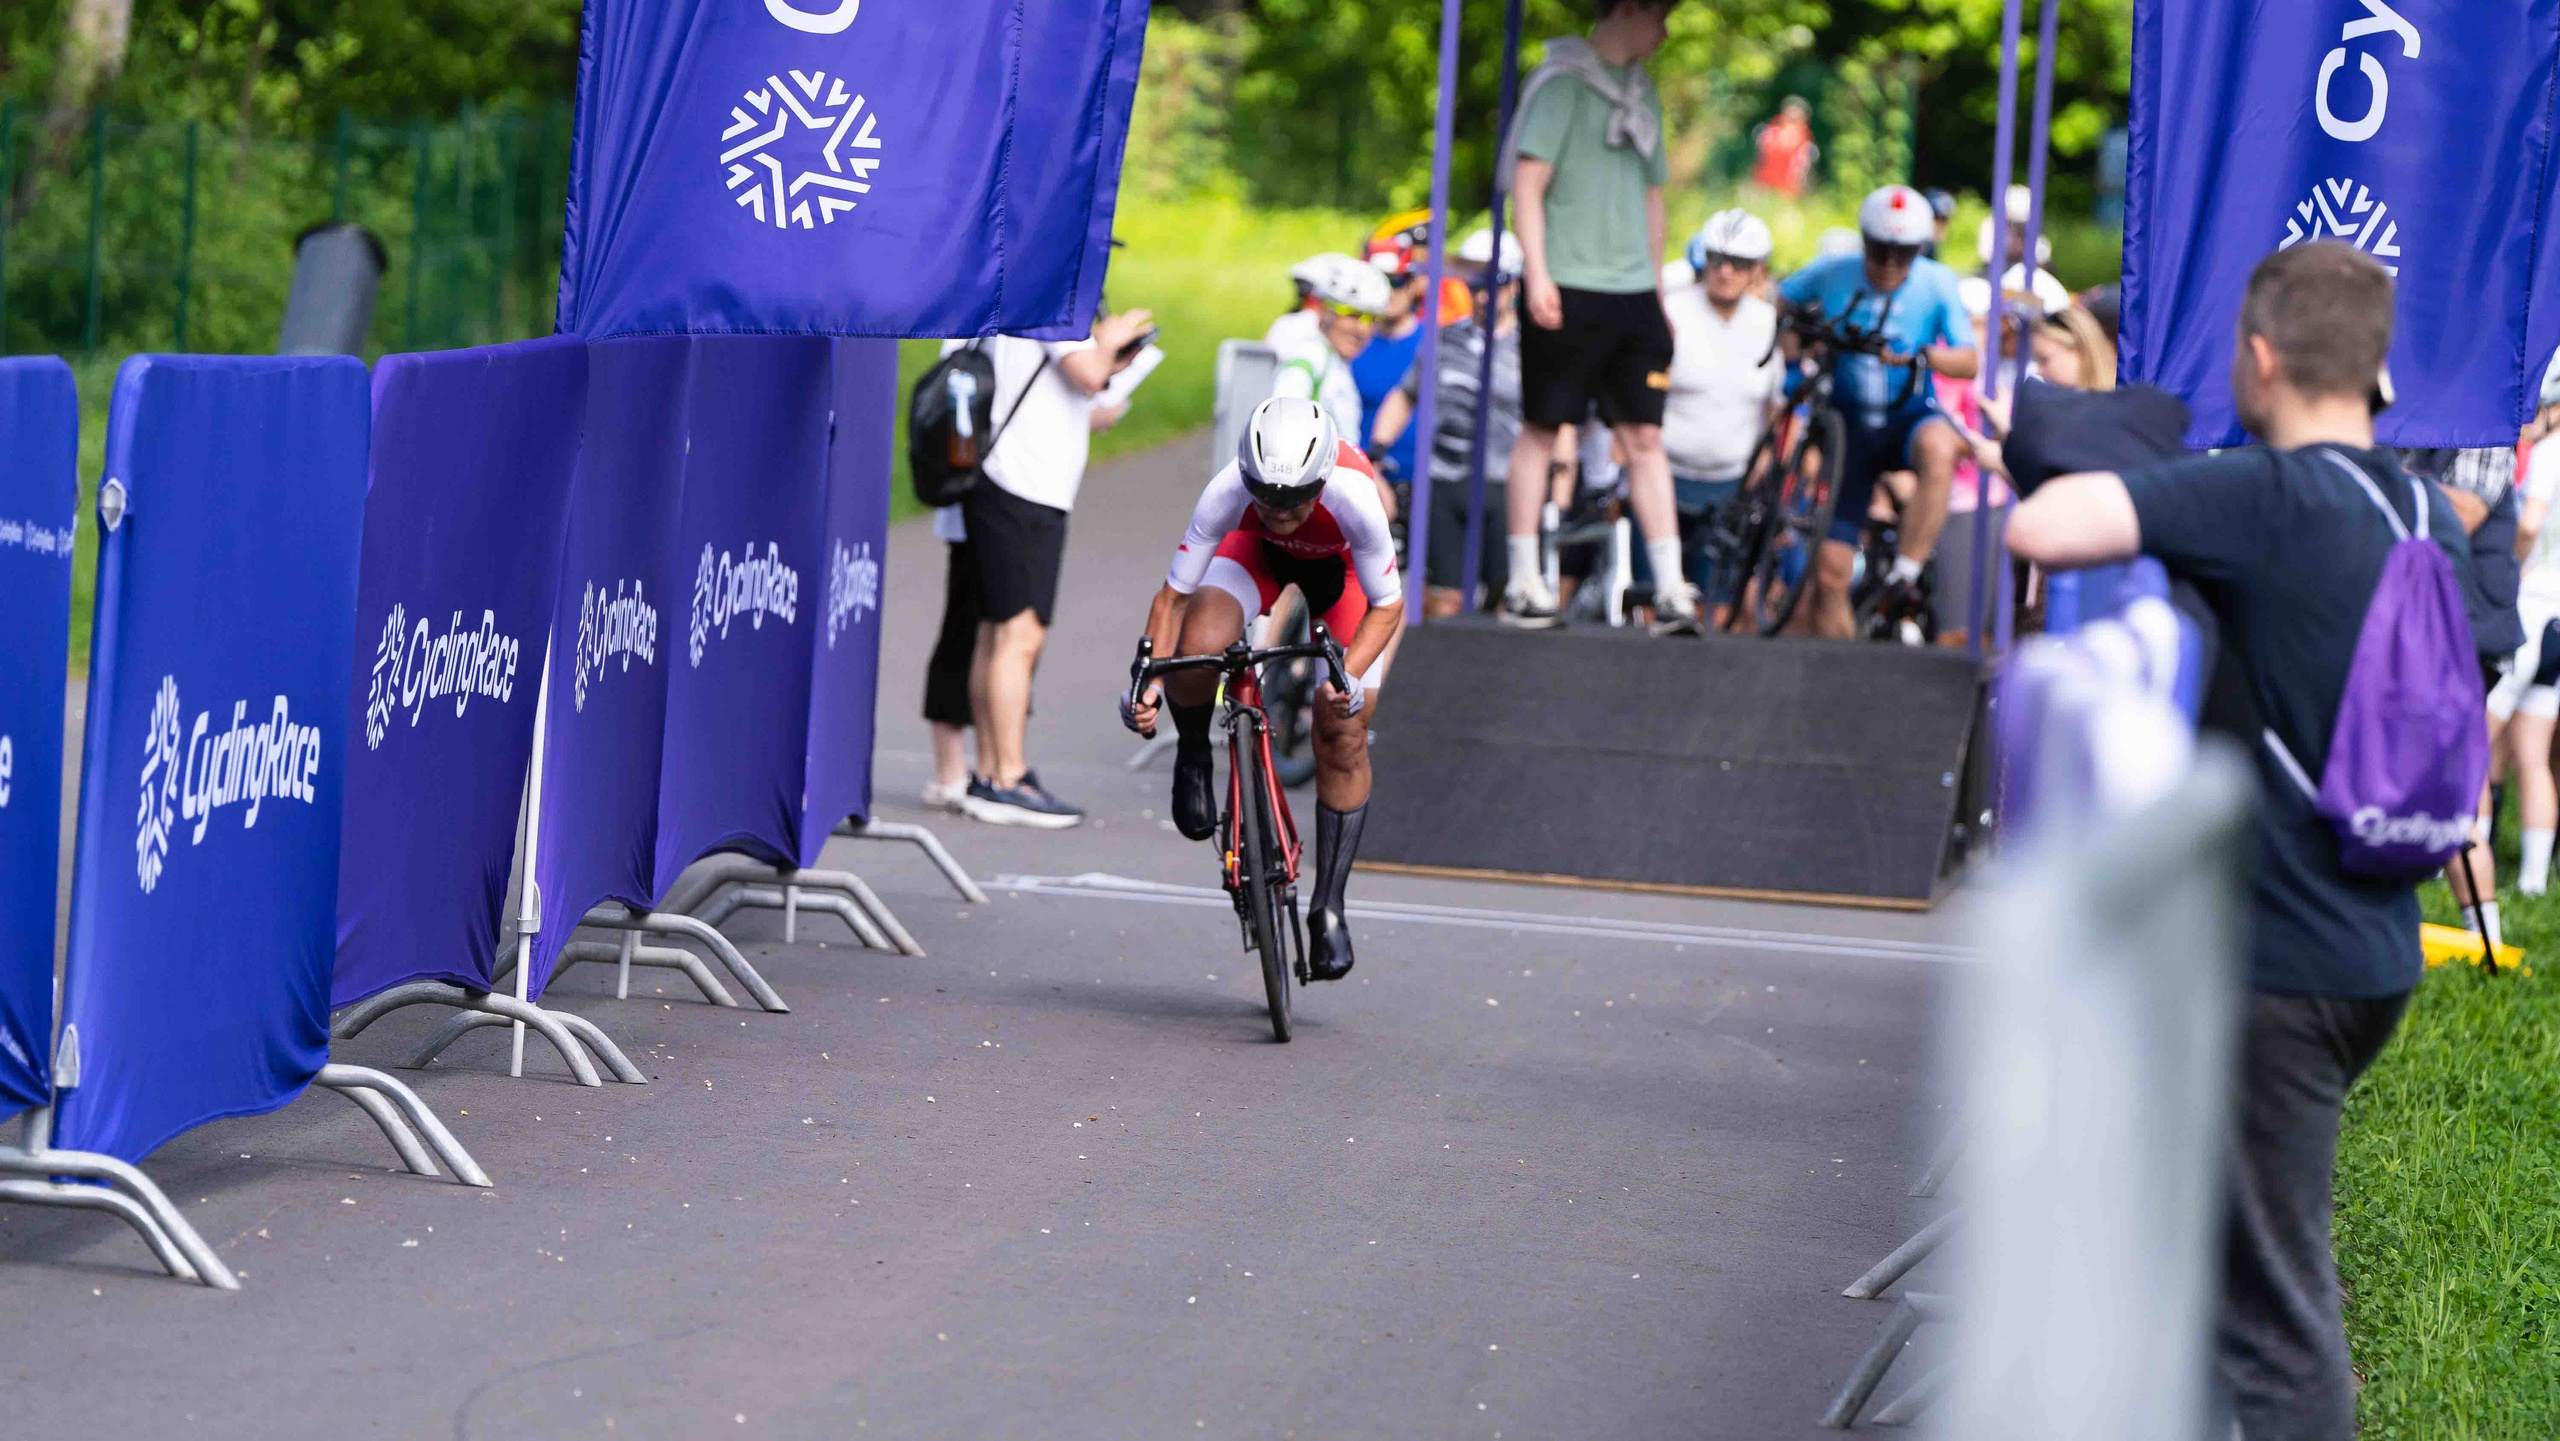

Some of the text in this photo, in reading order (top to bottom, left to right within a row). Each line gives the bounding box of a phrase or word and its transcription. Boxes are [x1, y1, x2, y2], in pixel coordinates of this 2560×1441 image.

[593, 580, 657, 682] CyclingRace
[713, 541, 798, 640] CyclingRace
[402, 610, 519, 728] CyclingRace
[182, 694, 321, 846] CyclingRace
